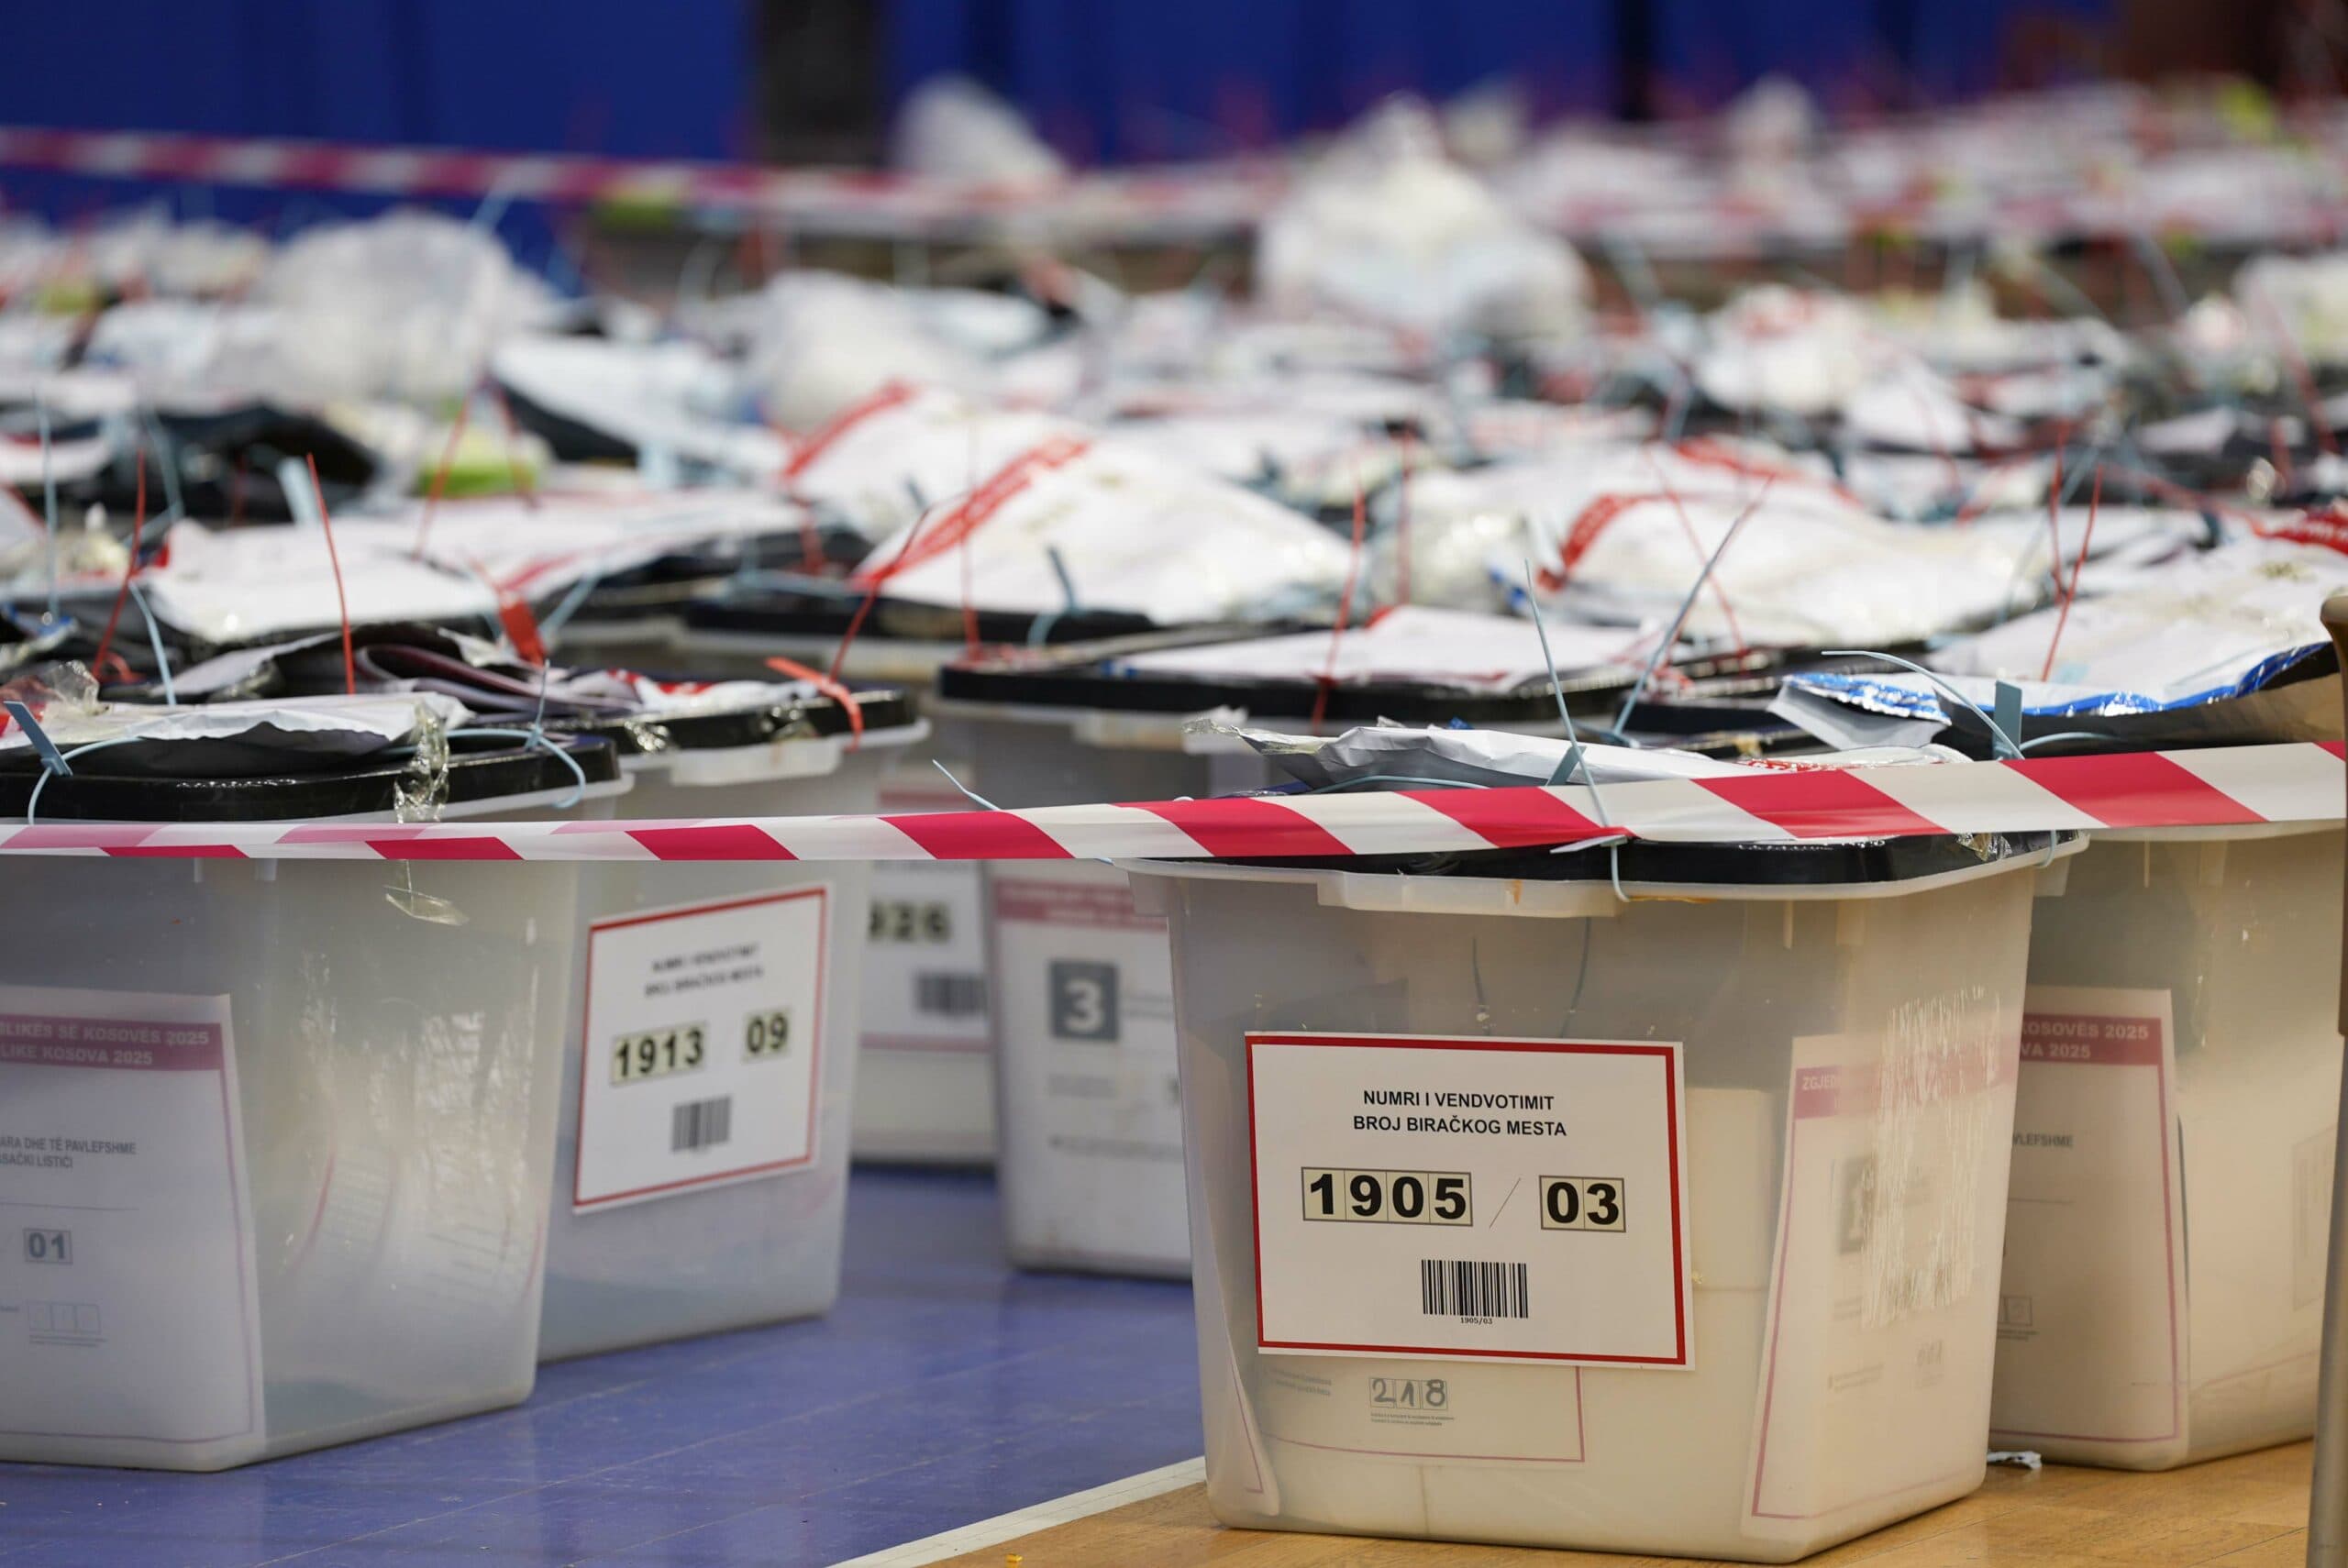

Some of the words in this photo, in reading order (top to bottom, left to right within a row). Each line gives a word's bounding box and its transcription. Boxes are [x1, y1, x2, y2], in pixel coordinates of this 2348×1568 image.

[1064, 978, 1104, 1033] 3
[83, 1026, 161, 1044] KOSOVËS
[166, 1031, 209, 1046] 2025
[2021, 1021, 2099, 1038] OSOVËS
[2105, 1024, 2149, 1040] 2025
[615, 1026, 704, 1077] 1913
[746, 1011, 789, 1055] 09
[2049, 1043, 2091, 1058] 2025
[43, 1045, 108, 1064] KOSOVA
[113, 1049, 153, 1065] 2025
[1363, 1090, 1421, 1106] NUMRI
[1425, 1092, 1430, 1106] I
[1434, 1092, 1555, 1110] VENDVOTIMIT
[1353, 1115, 1401, 1131] BROJ
[1407, 1115, 1501, 1134] BIRAČKOG
[1507, 1121, 1567, 1136] MESTA
[25, 1137, 46, 1151] DHE
[65, 1139, 137, 1155] PAVLEFSHME
[1309, 1173, 1468, 1220] 1905
[1545, 1181, 1620, 1226] 03
[28, 1231, 67, 1260] 01
[1460, 1317, 1493, 1325] 1905/03
[1372, 1378, 1446, 1408] 218
